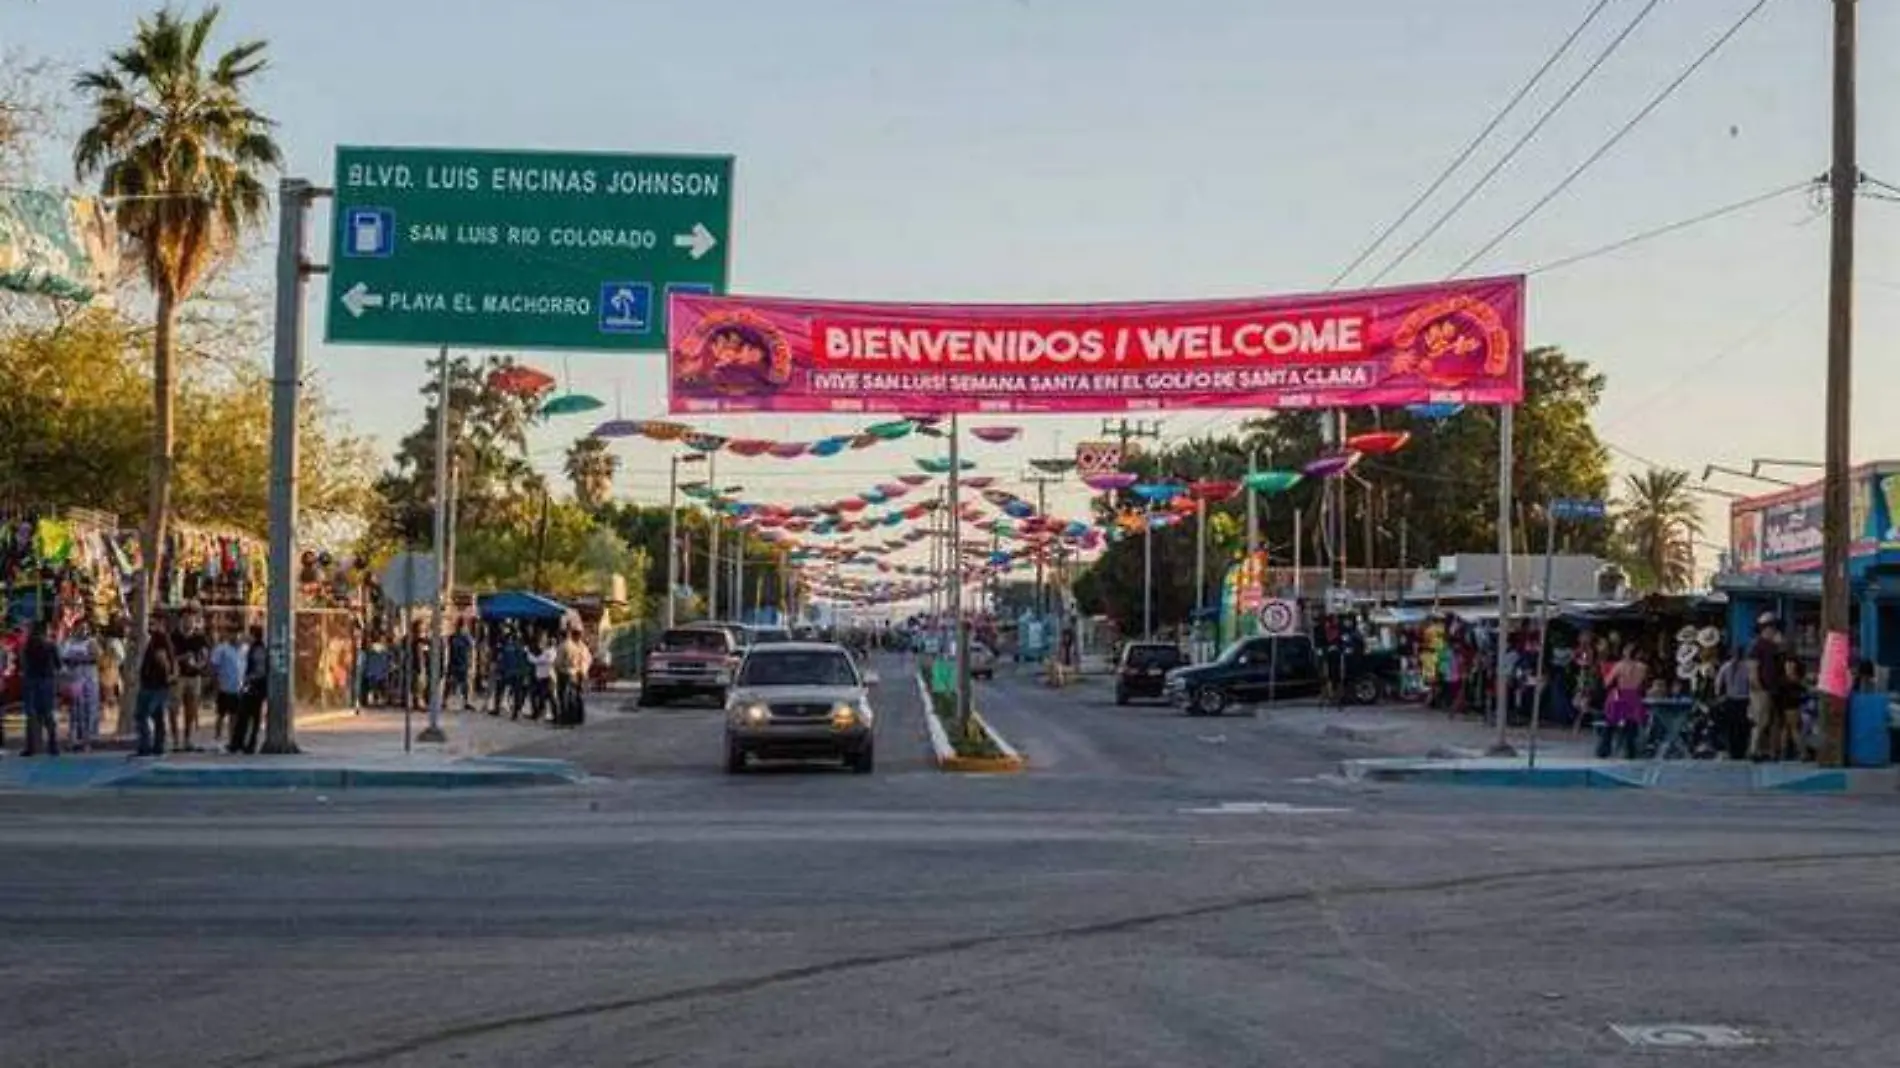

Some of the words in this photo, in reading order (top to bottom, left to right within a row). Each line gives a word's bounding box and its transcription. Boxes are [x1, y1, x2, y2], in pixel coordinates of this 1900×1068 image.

[348, 163, 414, 189] BLVD.
[426, 165, 480, 190] LUIS
[491, 167, 597, 194] ENCINAS
[605, 170, 719, 196] JOHNSON
[408, 224, 449, 242] SAN
[456, 225, 499, 245] LUIS
[507, 226, 541, 247] RIO
[550, 227, 657, 249] COLORADO
[389, 291, 446, 311] PLAYA
[452, 293, 477, 313] EL
[482, 295, 591, 315] MACHORRO
[825, 327, 1105, 363] BIENVENIDOS
[1137, 317, 1364, 361] WELCOME
[862, 373, 898, 391] SAN
[950, 374, 1026, 391] SEMANA
[1092, 374, 1120, 390] EN
[1122, 374, 1144, 389] EL
[1145, 371, 1211, 390] GOLFO
[1238, 369, 1300, 388] SANTA
[1303, 366, 1367, 385] CLARA
